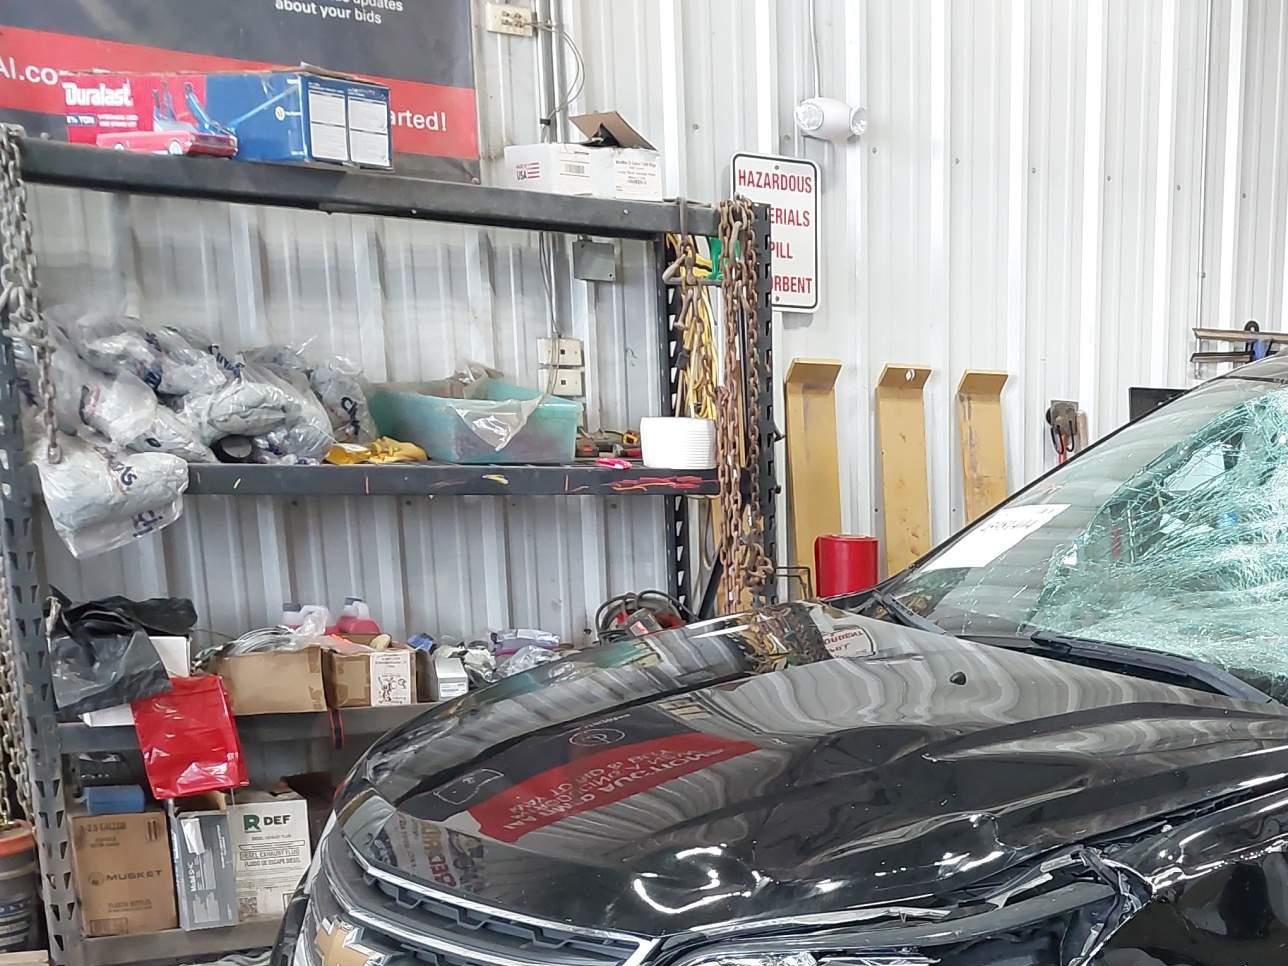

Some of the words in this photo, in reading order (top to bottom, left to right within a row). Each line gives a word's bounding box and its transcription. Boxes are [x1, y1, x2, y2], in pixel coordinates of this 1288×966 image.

[275, 0, 317, 15] about
[320, 5, 351, 19] your
[354, 7, 382, 24] bids
[0, 56, 59, 86] AI.co
[62, 79, 134, 107] Duralast
[391, 110, 448, 132] arted!
[516, 170, 528, 181] USA
[738, 168, 813, 194] HAZARDOUS
[768, 207, 811, 228] ERIALS
[243, 814, 262, 834] R
[263, 814, 291, 826] DEF
[106, 868, 163, 881] MUSKET
